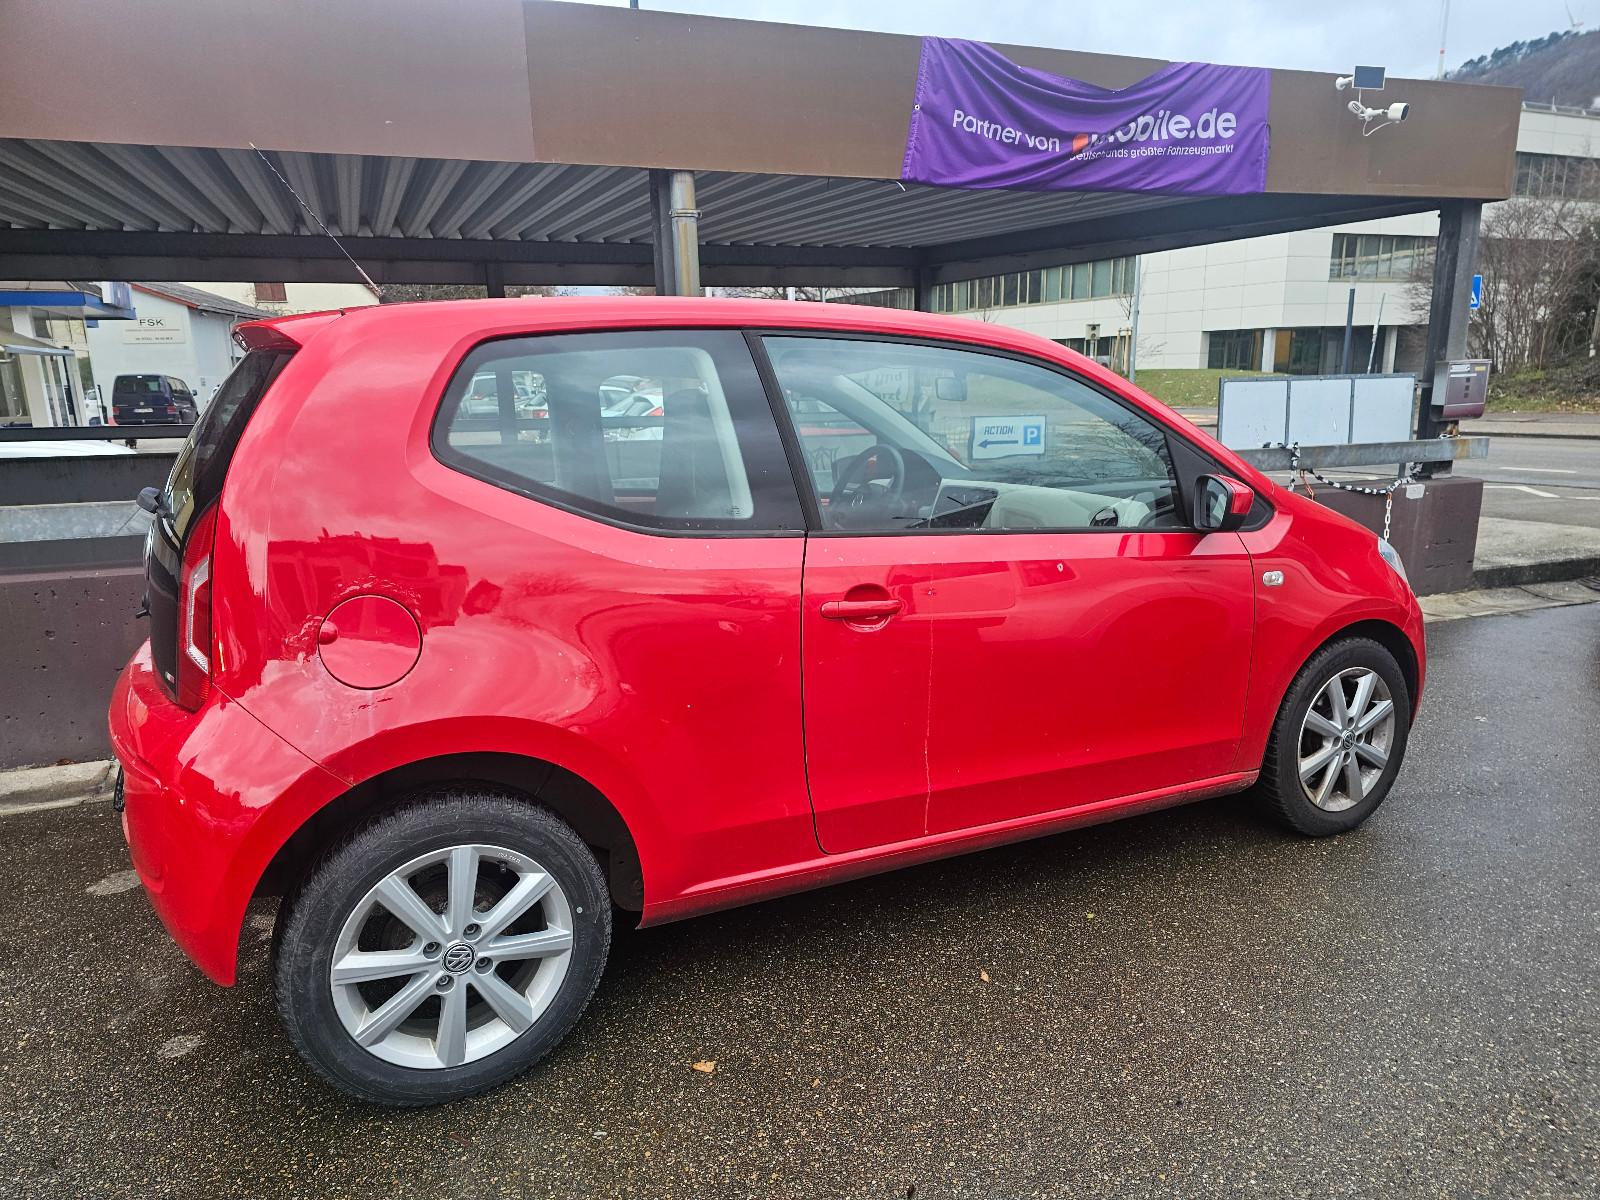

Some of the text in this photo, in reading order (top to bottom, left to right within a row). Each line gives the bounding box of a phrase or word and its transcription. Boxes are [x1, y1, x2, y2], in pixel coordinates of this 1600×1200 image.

[952, 109, 1060, 152] Partner von
[1130, 146, 1166, 158] größter
[139, 318, 164, 327] FSK
[983, 424, 1038, 444] ACTION P
